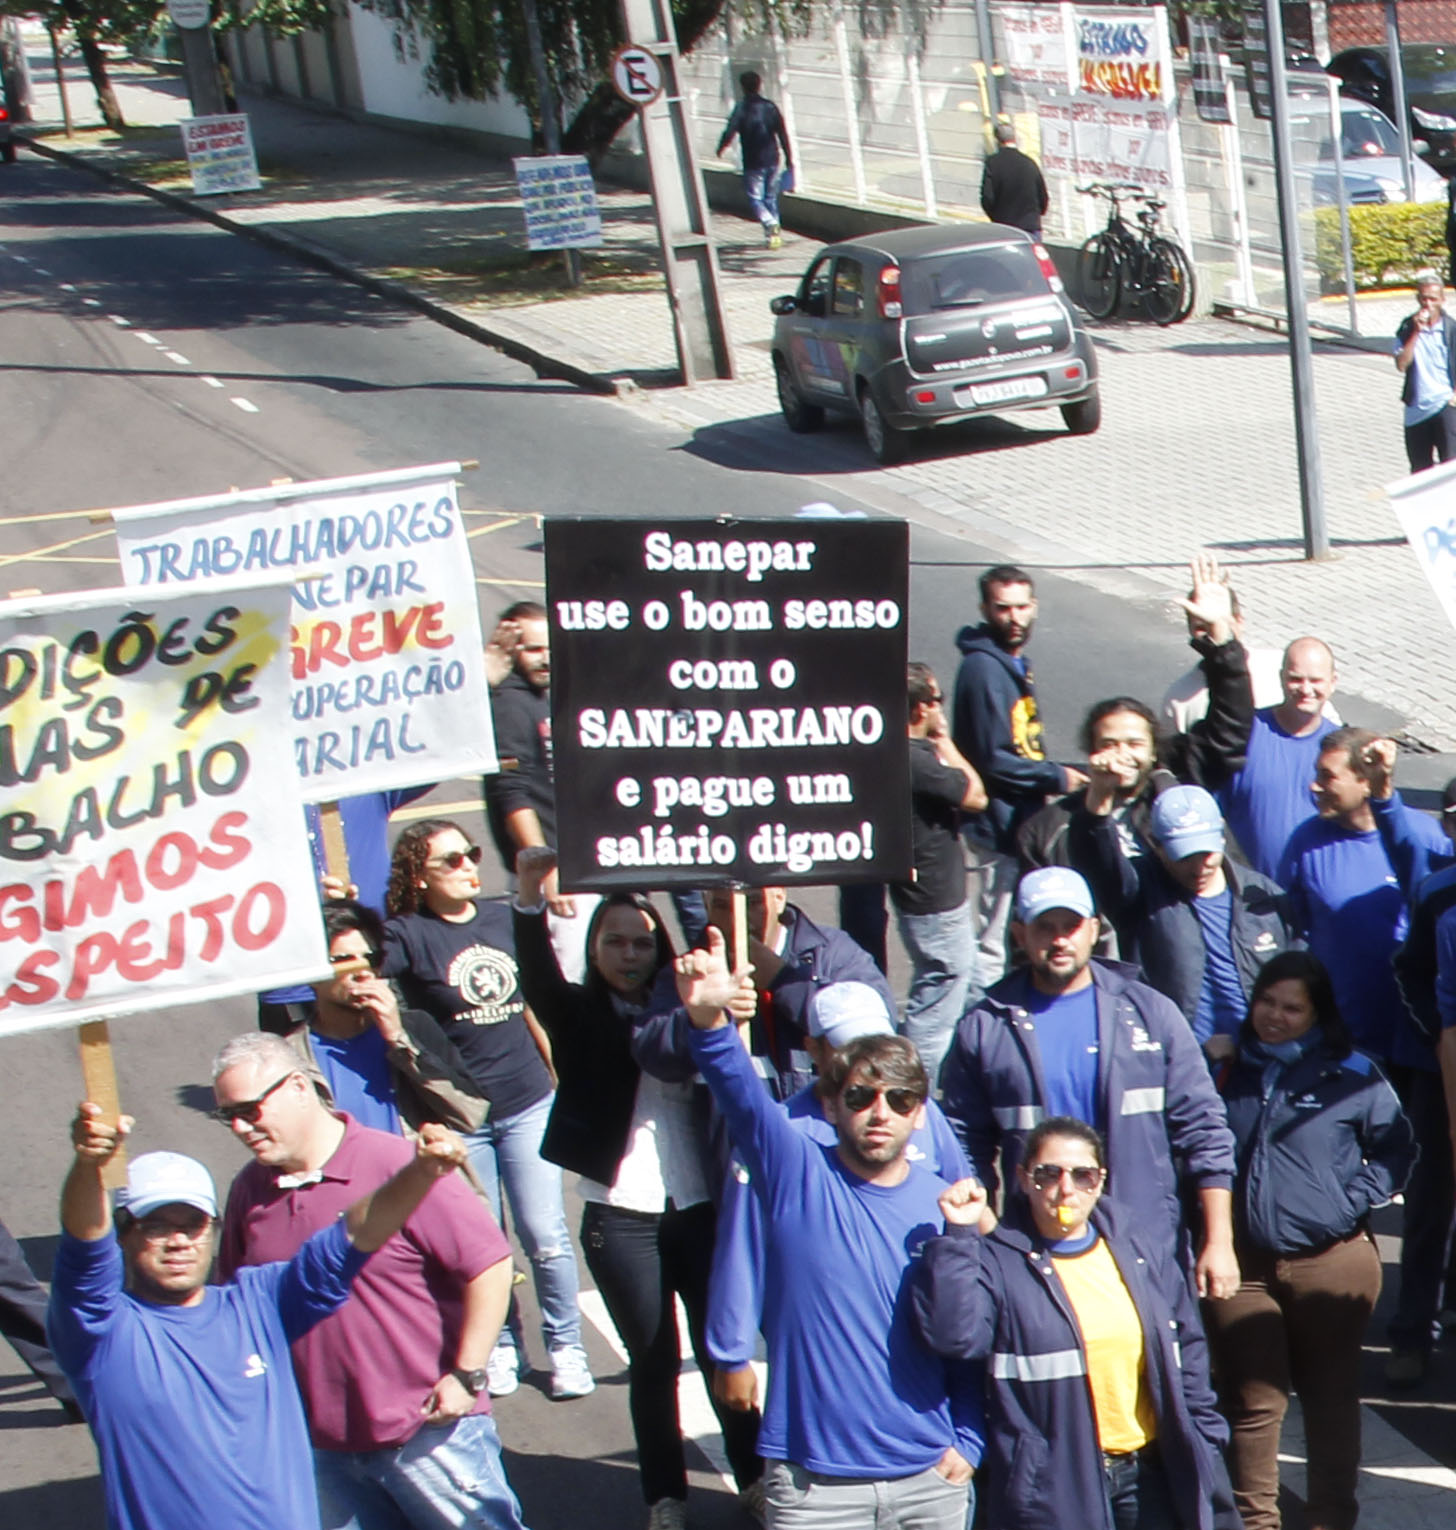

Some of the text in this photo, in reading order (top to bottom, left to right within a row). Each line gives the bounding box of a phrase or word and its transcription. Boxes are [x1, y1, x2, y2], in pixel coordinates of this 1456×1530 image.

[131, 497, 454, 586] TRABALHADORES
[645, 531, 816, 582] Sanepar
[556, 589, 900, 631] use o bom senso
[175, 663, 260, 730] DE
[668, 658, 796, 690] com o
[578, 704, 884, 749] SANEPARIANO
[0, 741, 250, 861] BALHO
[615, 772, 853, 818] e pague um
[596, 821, 874, 873] salário digno!
[0, 811, 252, 944] GIMOS
[0, 881, 287, 1011] SPEITO
